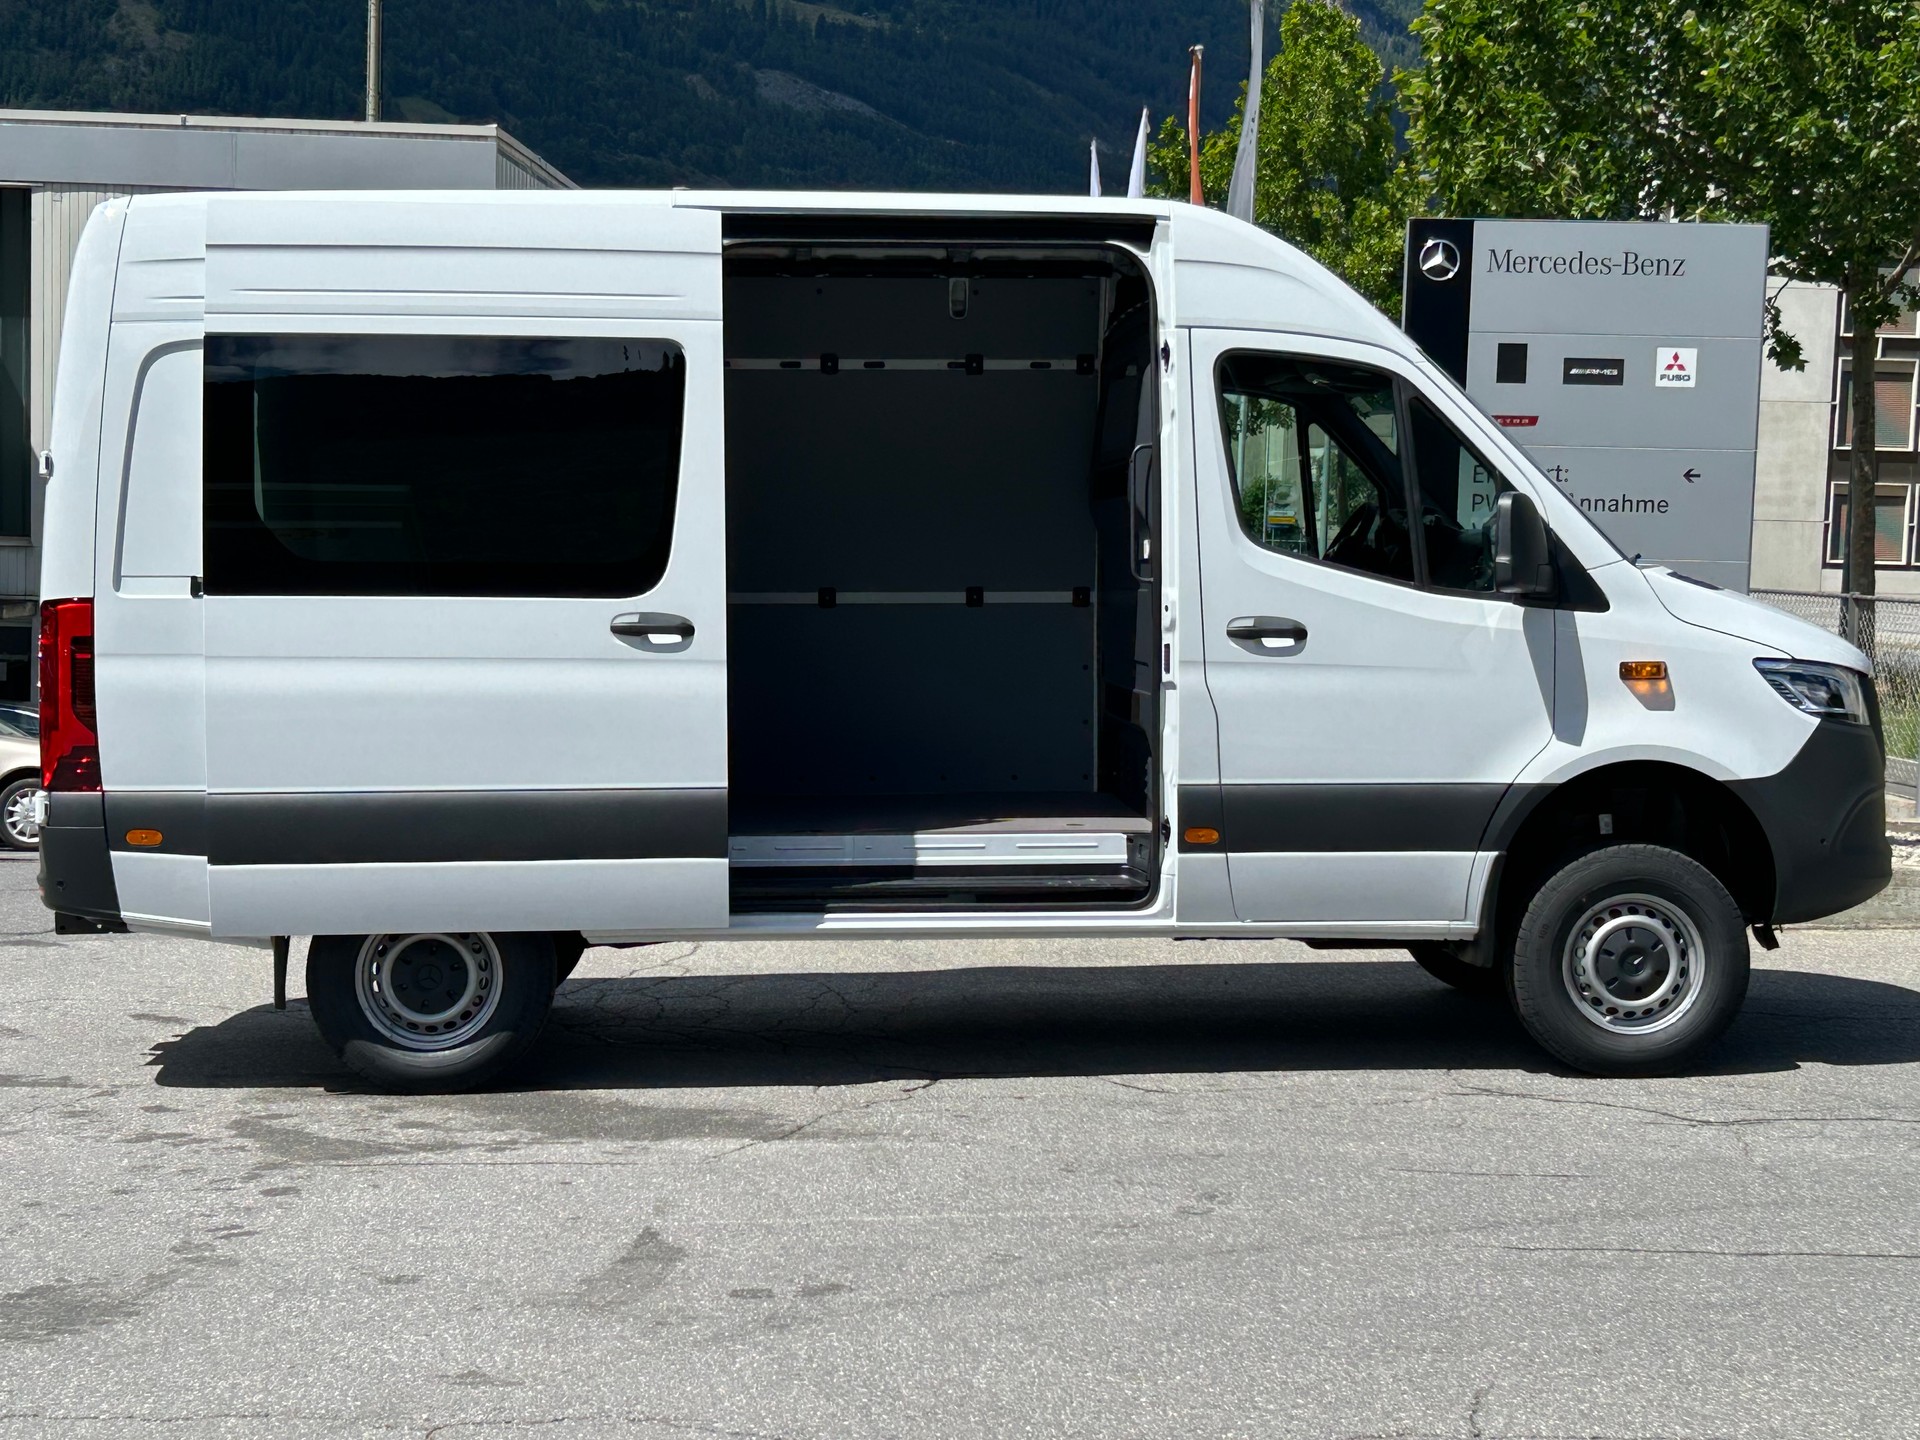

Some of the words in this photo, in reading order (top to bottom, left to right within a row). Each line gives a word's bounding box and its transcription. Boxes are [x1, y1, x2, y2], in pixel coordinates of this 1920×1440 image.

[1486, 248, 1686, 277] Mercedes-Benz
[1659, 374, 1691, 382] FUSO
[1568, 492, 1669, 514] nnahme
